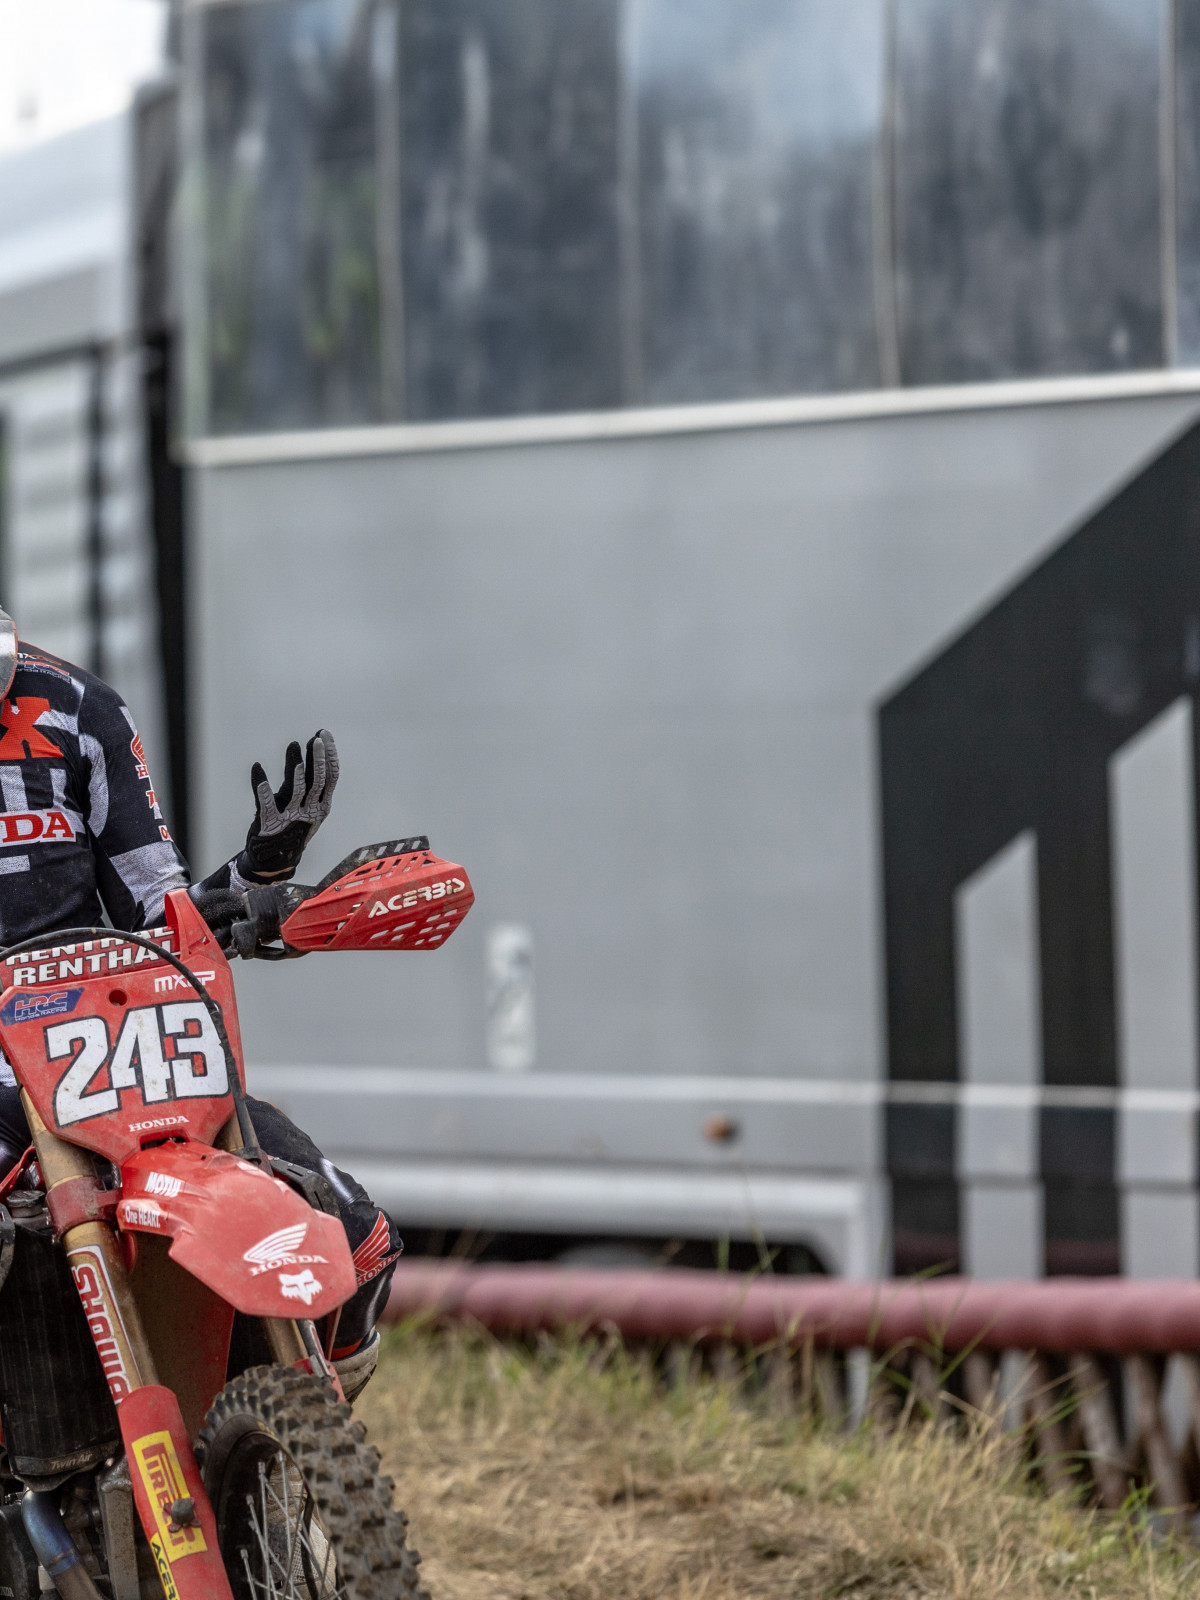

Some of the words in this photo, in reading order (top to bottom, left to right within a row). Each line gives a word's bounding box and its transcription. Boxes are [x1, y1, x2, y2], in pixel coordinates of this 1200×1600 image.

[12, 939, 181, 986] RENTHAL
[14, 991, 69, 1019] HRC
[43, 1000, 231, 1130] 243
[127, 1115, 190, 1133] HONDA
[124, 1205, 138, 1224] One
[249, 1254, 330, 1277] HONDA
[71, 1264, 132, 1405] SHOWA
[51, 1458, 76, 1470] Twin
[77, 1453, 93, 1464] Air
[141, 1442, 196, 1547] PIRELI
[152, 1541, 181, 1600] ACER
